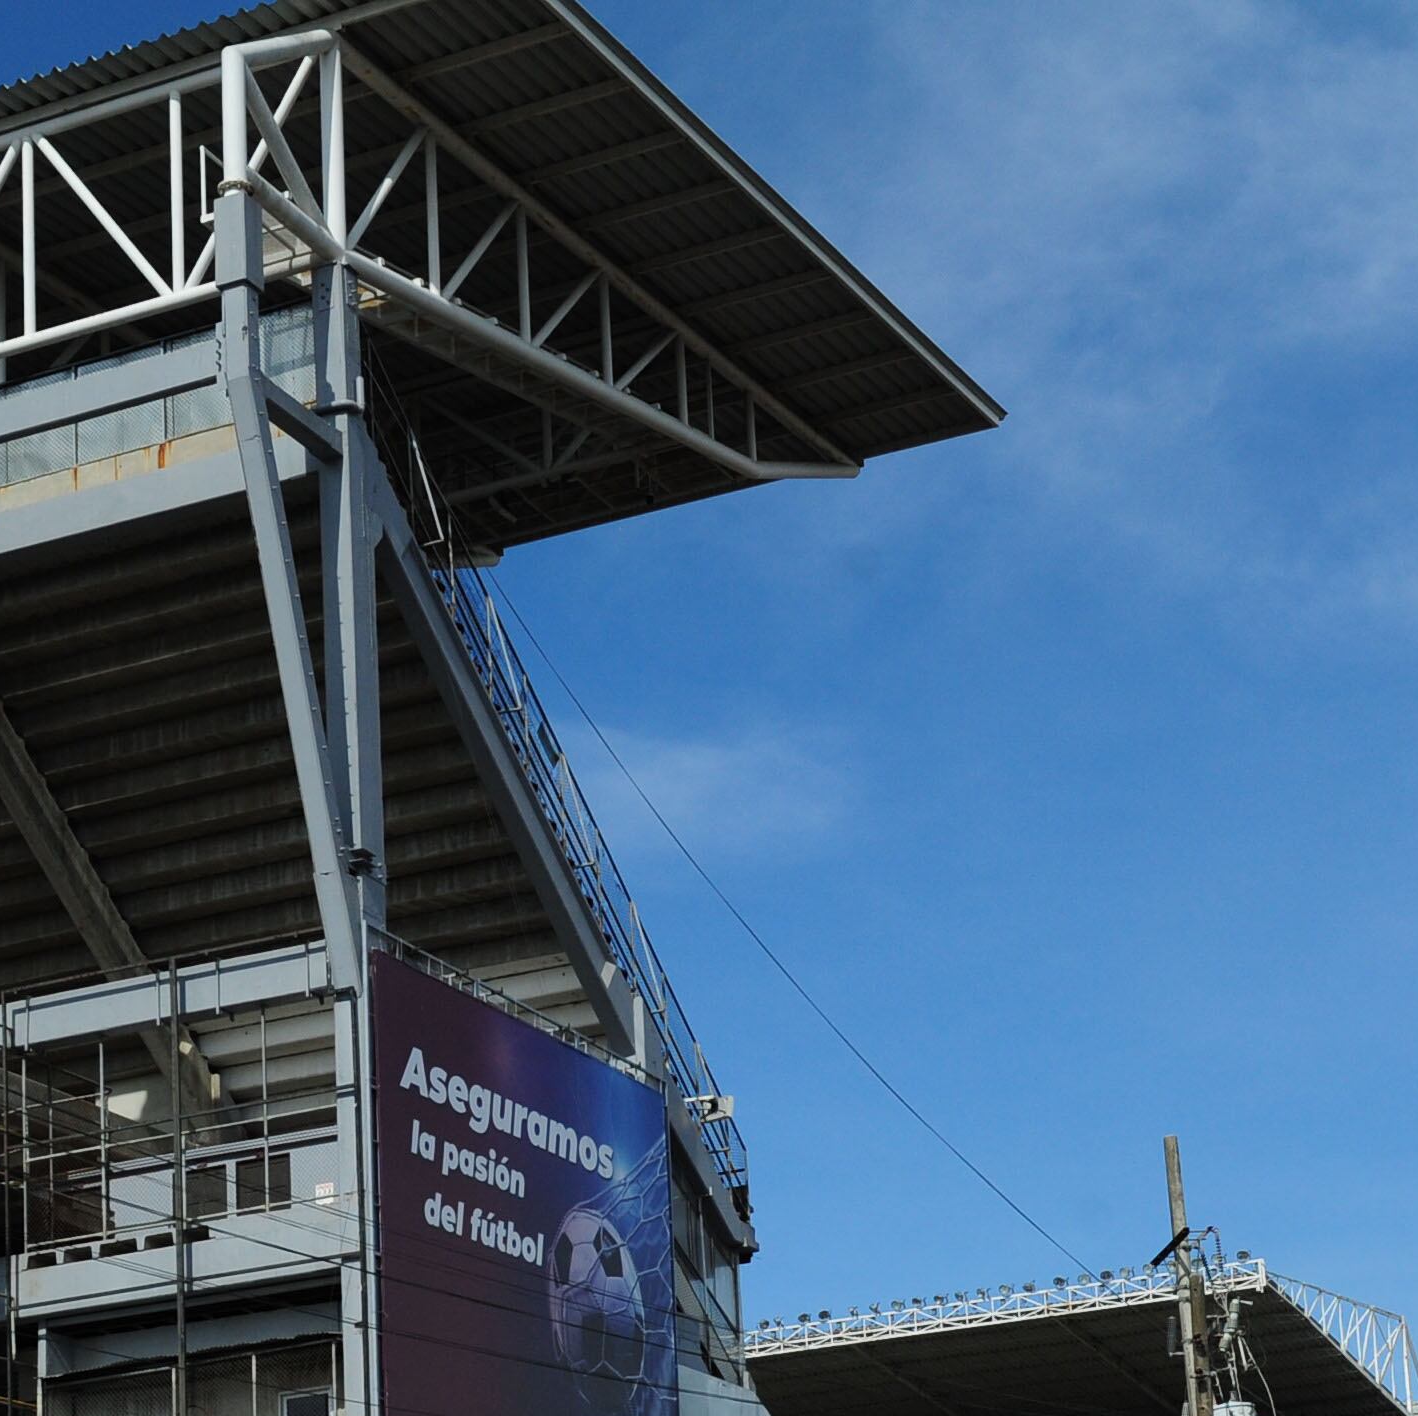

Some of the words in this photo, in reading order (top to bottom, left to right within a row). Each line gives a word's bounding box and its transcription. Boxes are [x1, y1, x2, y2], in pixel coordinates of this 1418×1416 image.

[399, 1047, 614, 1179] Aseguramos
[410, 1119, 436, 1161] la
[442, 1141, 525, 1198] pasión
[424, 1192, 465, 1237] del
[470, 1207, 544, 1267] fútbol
